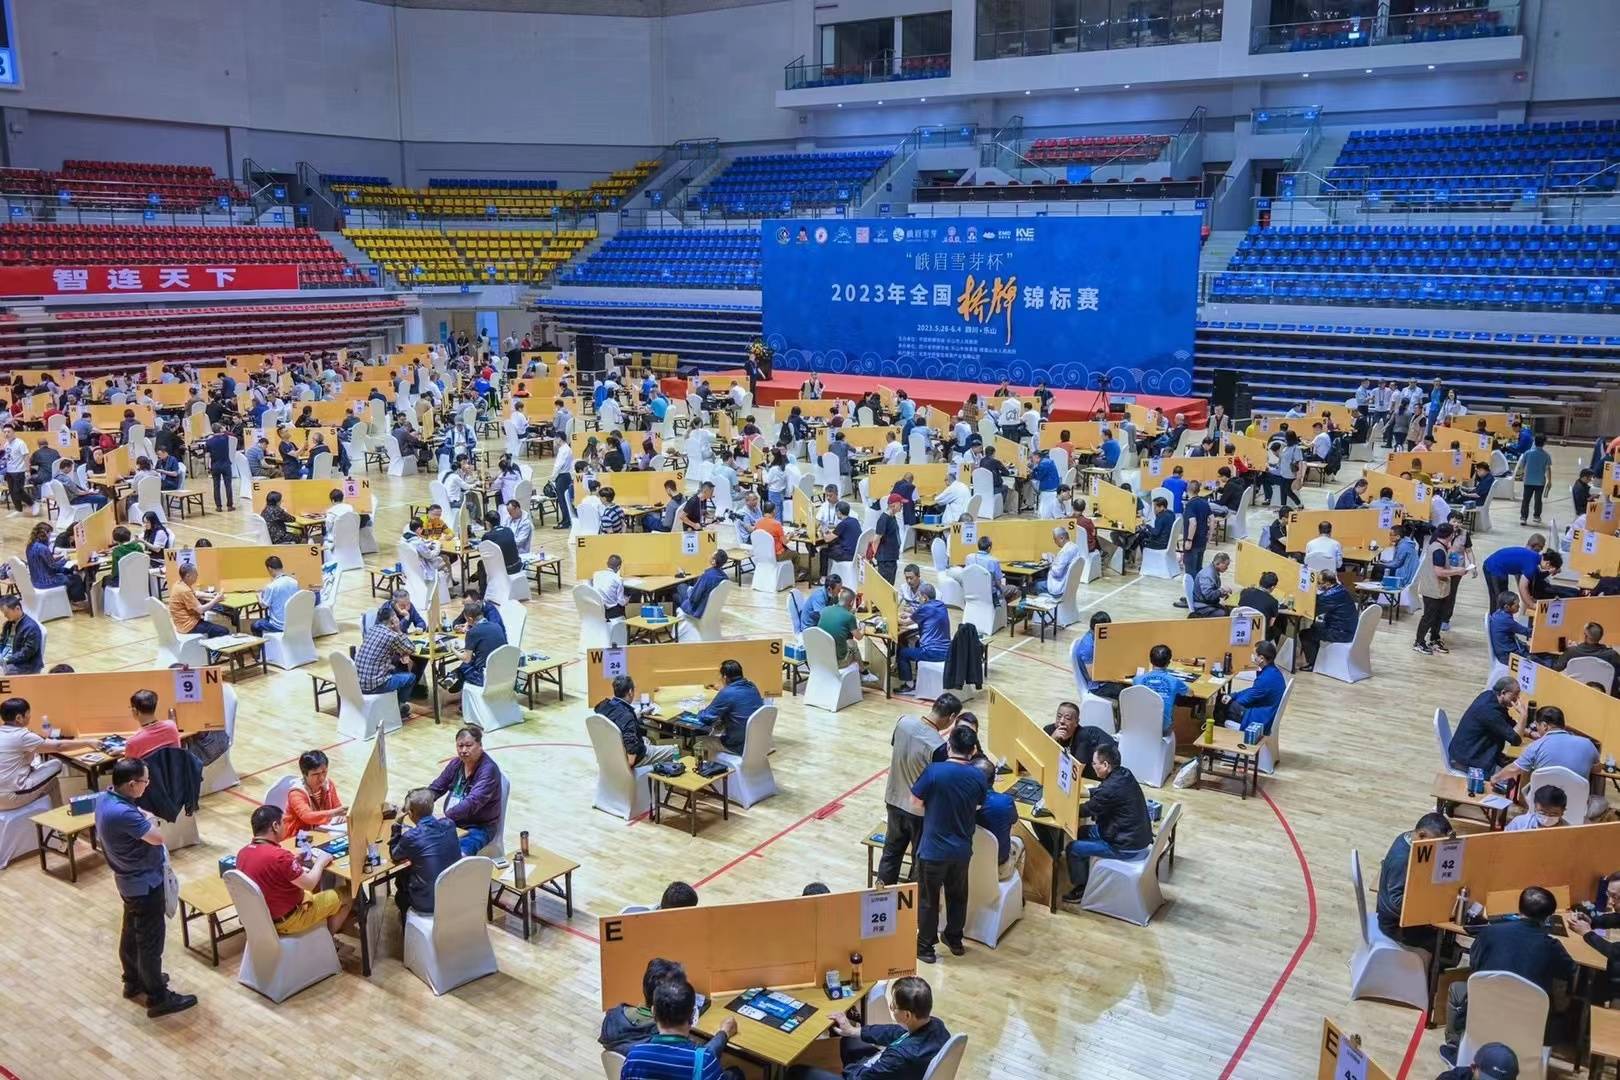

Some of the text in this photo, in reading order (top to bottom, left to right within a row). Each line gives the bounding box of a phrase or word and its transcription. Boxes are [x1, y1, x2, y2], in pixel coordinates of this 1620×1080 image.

[53, 268, 237, 290] 智连天下
[1069, 521, 1074, 530] S
[578, 538, 585, 547] E
[168, 552, 176, 561] W
[311, 547, 318, 556] S
[1310, 573, 1315, 583] S
[1541, 603, 1548, 613] W
[1252, 618, 1260, 630] N
[1099, 627, 1107, 639] E
[771, 642, 779, 654] S
[591, 652, 603, 663] W
[1511, 658, 1518, 672] E
[206, 671, 217, 684] N
[0, 680, 11, 694] E
[185, 681, 194, 692] 9
[1061, 769, 1068, 779] 27
[1072, 765, 1077, 781] S
[1418, 845, 1432, 863] W
[1442, 859, 1455, 869] 42
[898, 890, 912, 910] N
[872, 913, 887, 923] 26
[606, 921, 623, 941] E
[1327, 1028, 1339, 1058] E
